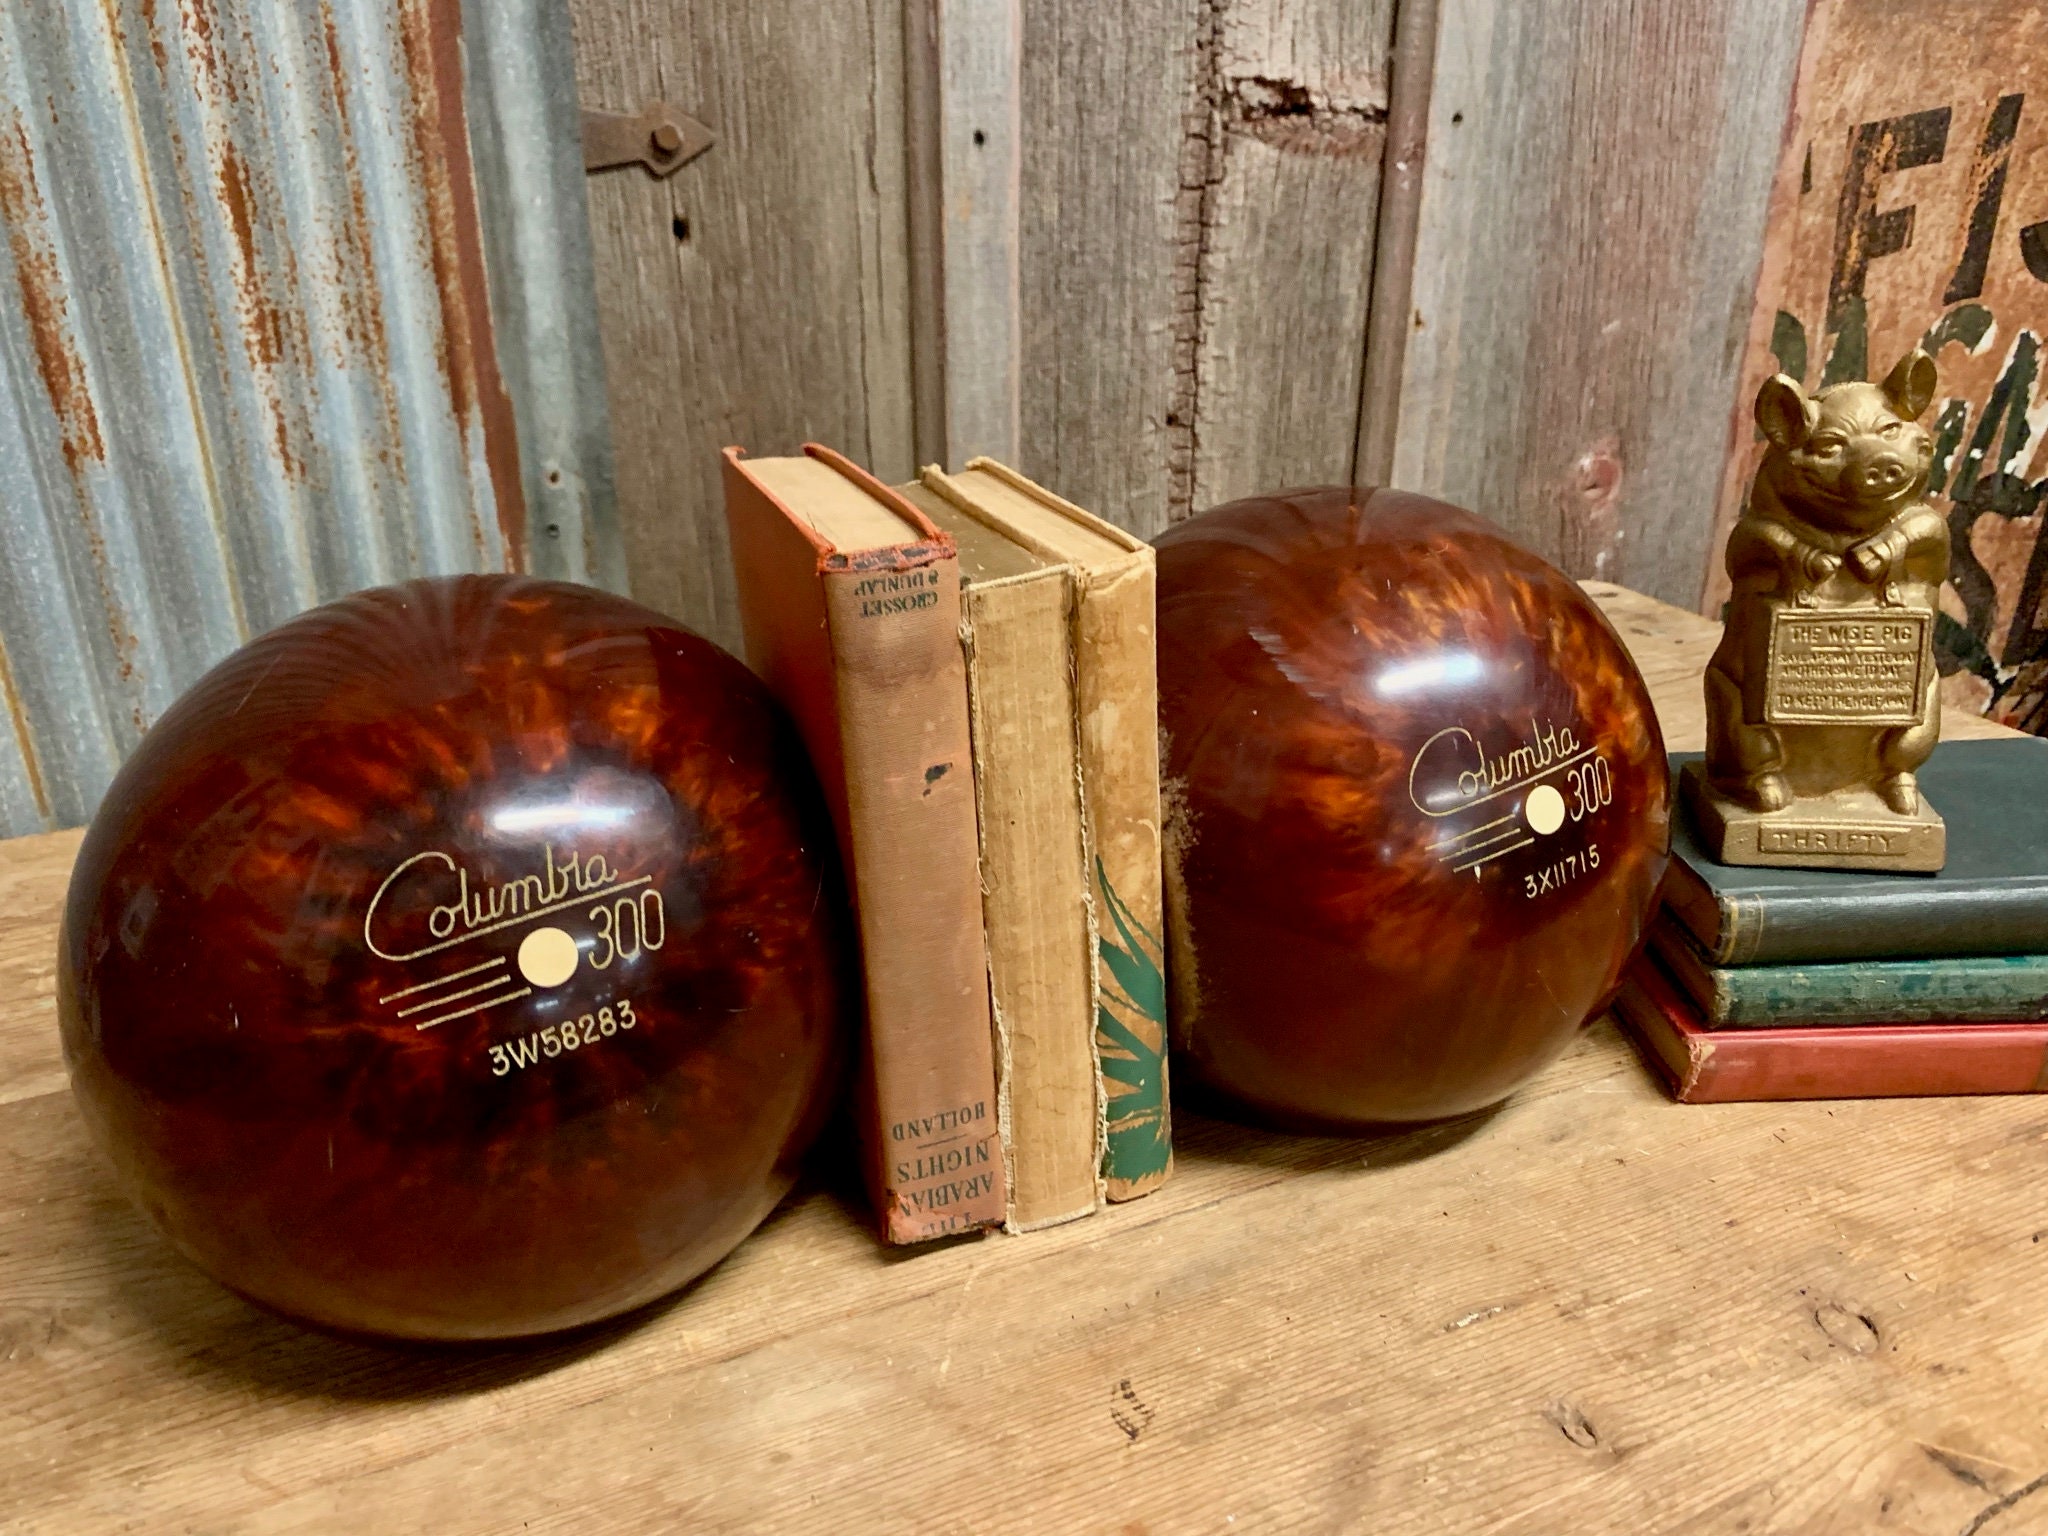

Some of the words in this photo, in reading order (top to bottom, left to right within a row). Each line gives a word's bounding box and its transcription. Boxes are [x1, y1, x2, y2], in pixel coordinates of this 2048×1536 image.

[854, 571, 925, 597] DUNLAP
[1789, 625, 1823, 644] THE
[1828, 624, 1876, 644] WISE
[1881, 625, 1913, 645] PIG
[1409, 717, 1580, 817] Columbia
[1567, 756, 1612, 822] 300
[1772, 833, 1896, 852] THRIFTY
[365, 841, 620, 961] Columbia
[588, 888, 665, 970] 300
[488, 999, 637, 1077] 3W58283
[892, 1101, 986, 1141] HOLLAND
[897, 1141, 990, 1184] NIGHTS
